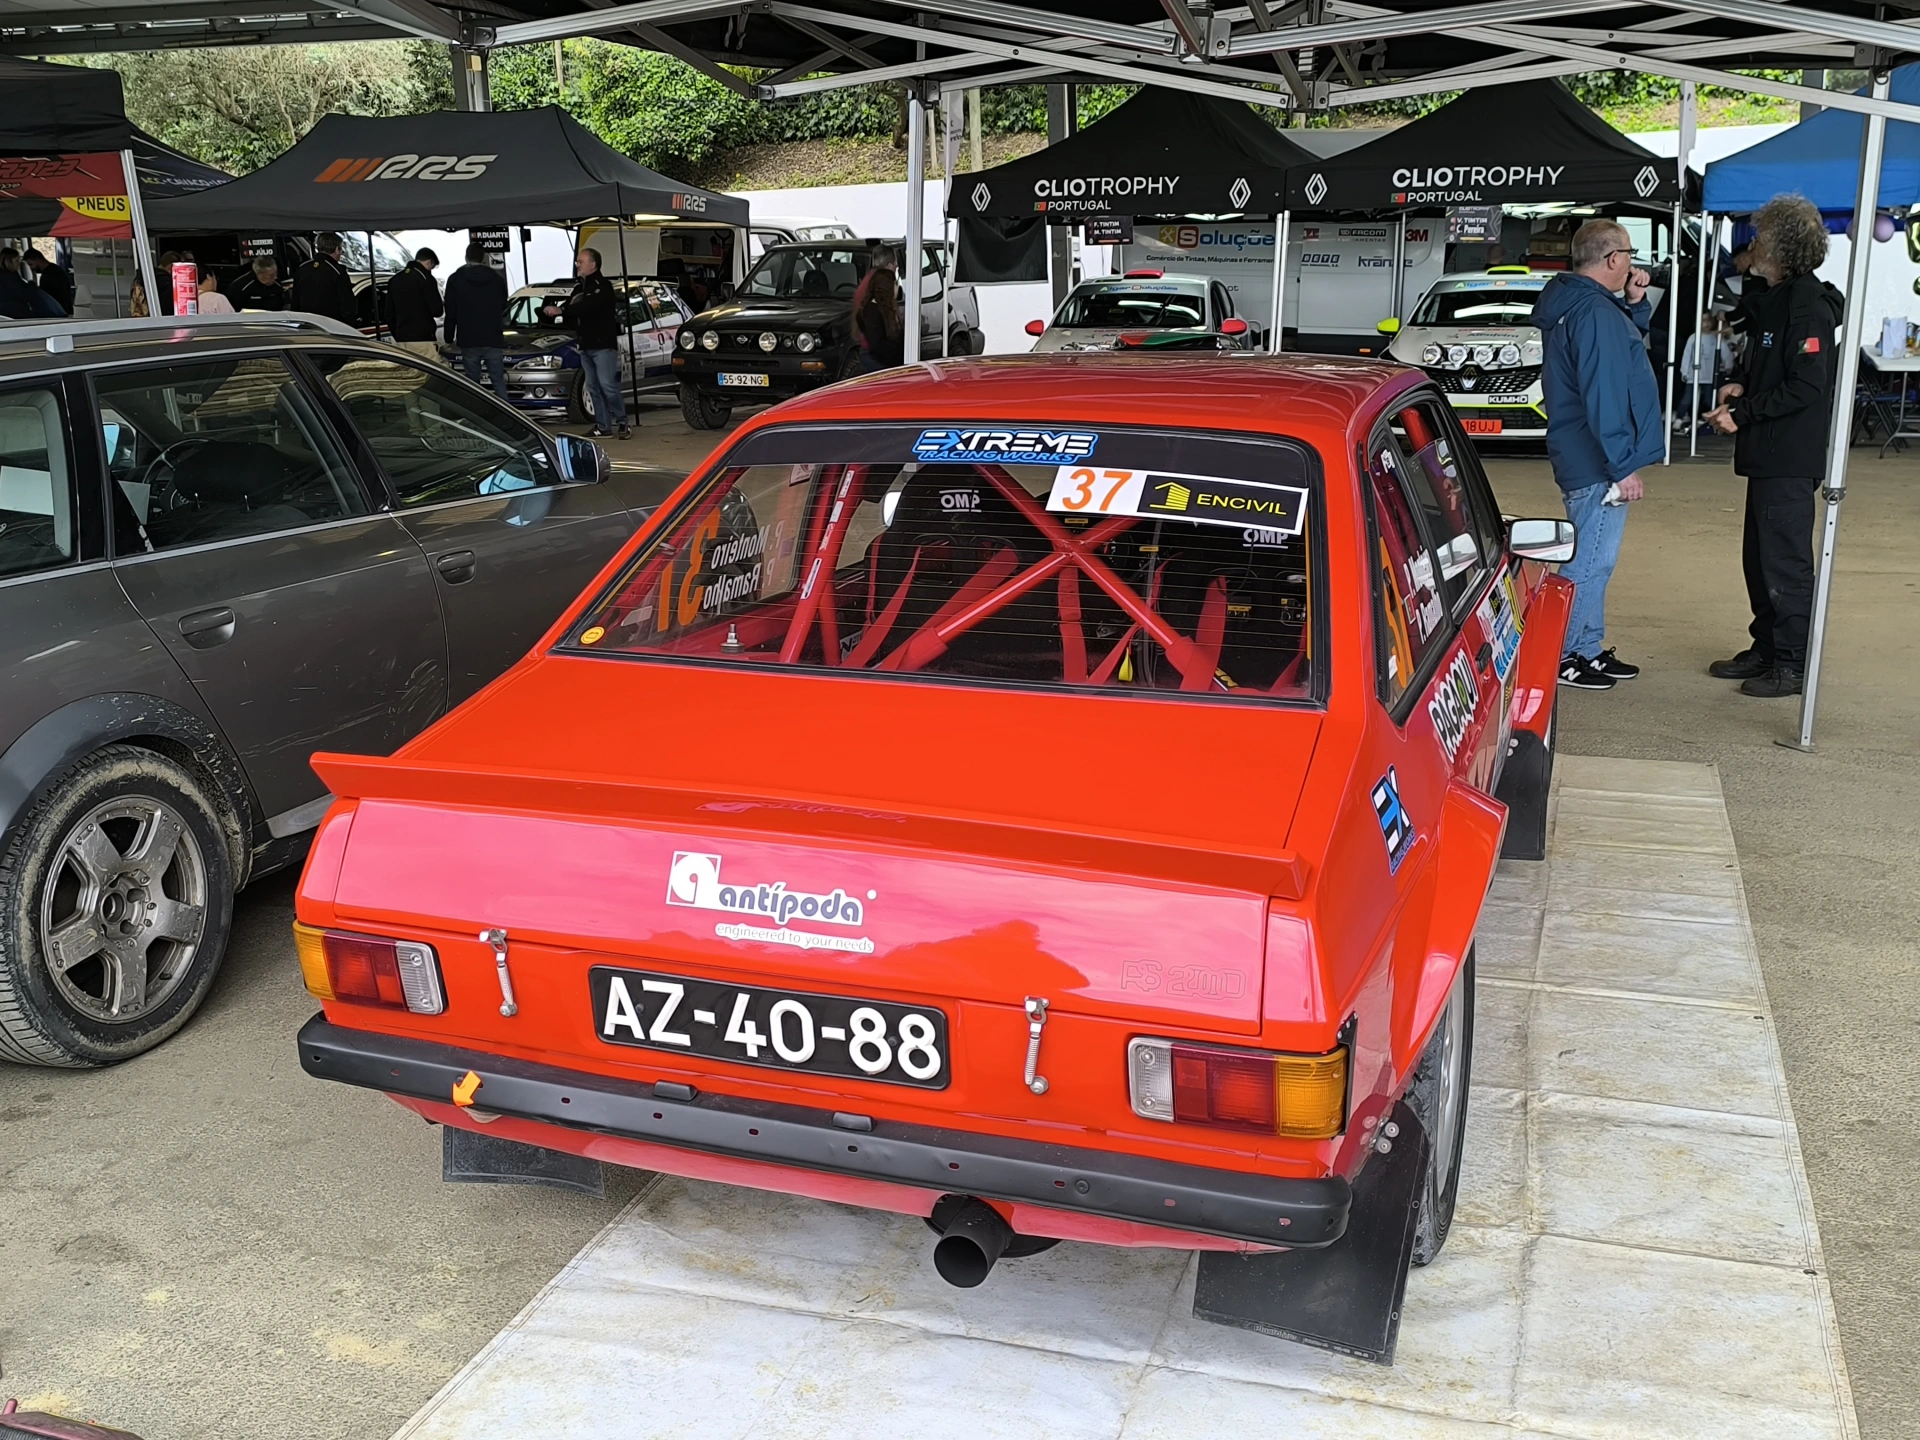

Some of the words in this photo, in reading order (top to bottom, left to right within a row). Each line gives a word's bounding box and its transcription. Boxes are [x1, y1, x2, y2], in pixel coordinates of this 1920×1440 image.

[364, 154, 498, 181] RRS
[1392, 166, 1564, 188] CLIOTROPHY
[1034, 176, 1180, 197] CLIOTROPHY
[1407, 191, 1482, 203] PORTUGAL
[77, 197, 126, 211] PNEUS
[683, 193, 707, 212] RRS
[1047, 200, 1111, 211] PORTUGAL
[1179, 228, 1275, 251] Soluçõe
[1405, 229, 1429, 242] 3M
[917, 432, 1093, 455] EXTREME
[924, 451, 998, 459] RACING
[999, 451, 1075, 462] WORKS
[1062, 468, 1133, 511] 37
[940, 494, 980, 508] OMP
[1196, 494, 1287, 516] ENCIVIL
[1243, 529, 1288, 544] OMP
[718, 882, 861, 922] antípoda
[717, 924, 785, 941] engineered
[788, 931, 801, 943] to
[805, 935, 832, 947] your
[836, 938, 872, 953] needs
[603, 976, 941, 1080] AZ-40-88
